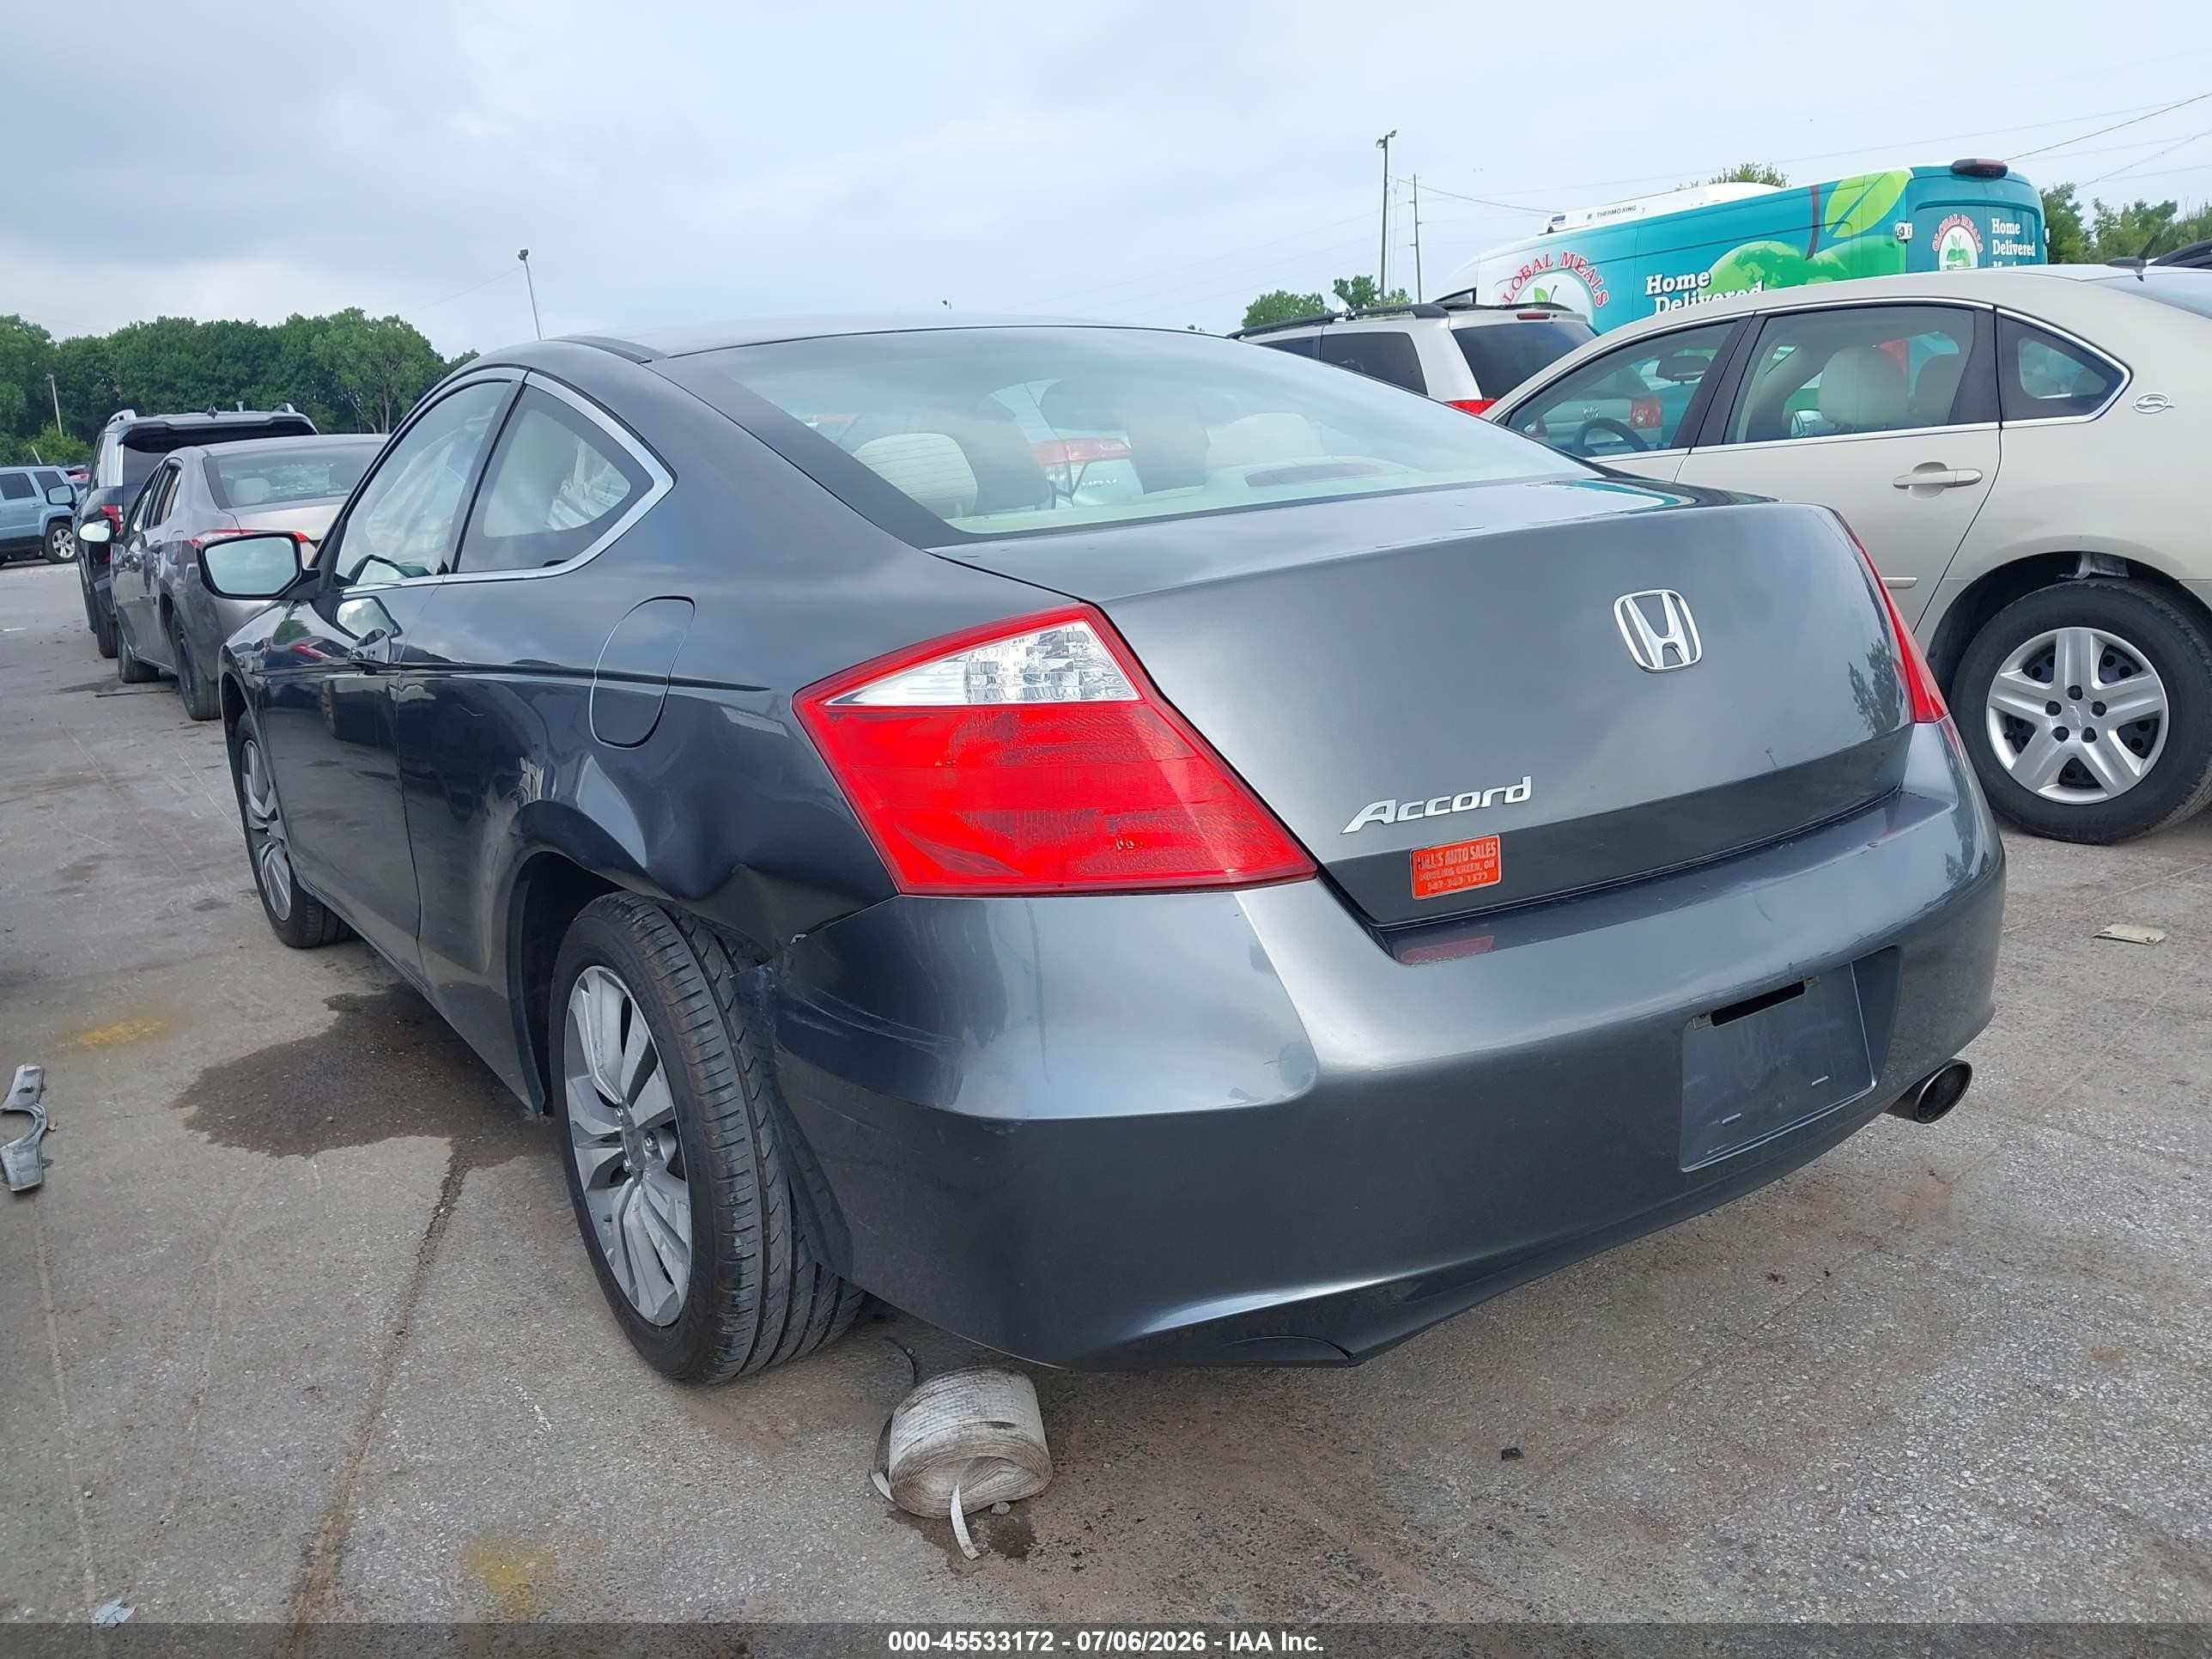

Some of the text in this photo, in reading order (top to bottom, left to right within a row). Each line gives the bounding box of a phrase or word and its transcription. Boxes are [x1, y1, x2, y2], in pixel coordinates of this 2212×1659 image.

[1991, 217, 2021, 235] Home
[1991, 239, 2036, 257] Delivered
[1502, 250, 1609, 307] LOBAL MEALS
[1645, 270, 1711, 295] Home
[1340, 775, 1532, 835] Accord
[1445, 847, 1469, 866] AUTO
[1470, 841, 1497, 860] SALES
